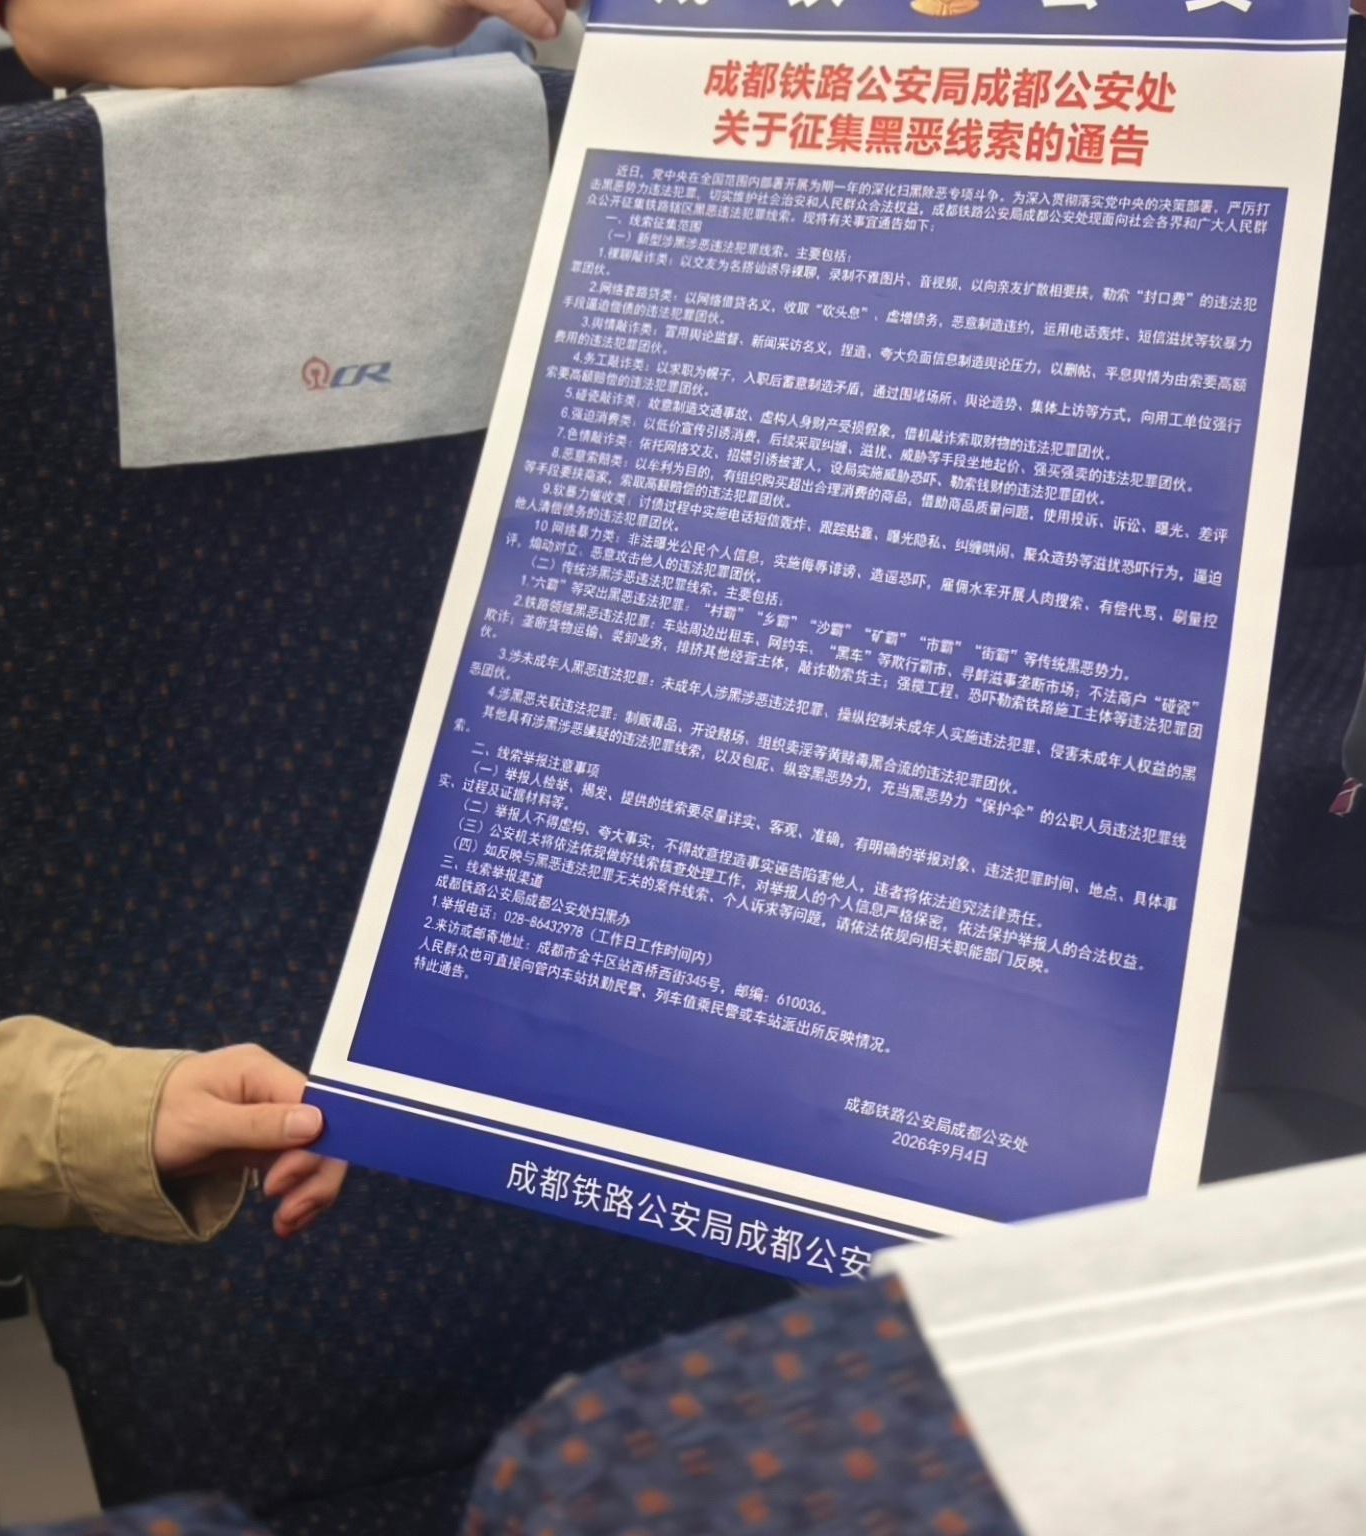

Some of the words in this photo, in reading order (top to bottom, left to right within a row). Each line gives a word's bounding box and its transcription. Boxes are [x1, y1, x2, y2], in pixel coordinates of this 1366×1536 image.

[703, 58, 1177, 114] 成都铁路公安局成都公安处
[711, 107, 1151, 167] 关于征集黑恶线索的通告
[604, 211, 702, 233] 一、线索征集范围
[569, 259, 612, 279] 罪团伙。
[561, 294, 727, 325] 手段逼迫偿债的违法犯罪团伙。
[553, 329, 669, 357] 费用的违法犯罪团伙。
[544, 365, 710, 399] 索要高额赔偿的违法犯罪团伙。
[513, 495, 680, 533] 他人清偿债务的违法犯罪团伙。
[479, 622, 498, 642] 伙。
[467, 659, 513, 683] 恶团伙。
[451, 716, 472, 736] 索。
[470, 739, 600, 779] 二、线索举报注意事项
[437, 771, 571, 813] 实、过程及证据材料等。
[440, 852, 544, 890] 三、线索举报渠道
[434, 871, 632, 929] 成都铁路公安局成都公安处扫黑办
[412, 952, 471, 984] 特此通告。
[843, 1095, 1030, 1154] 成都铁路公安局成都公安处
[891, 1130, 989, 1168] 2026年9月4日
